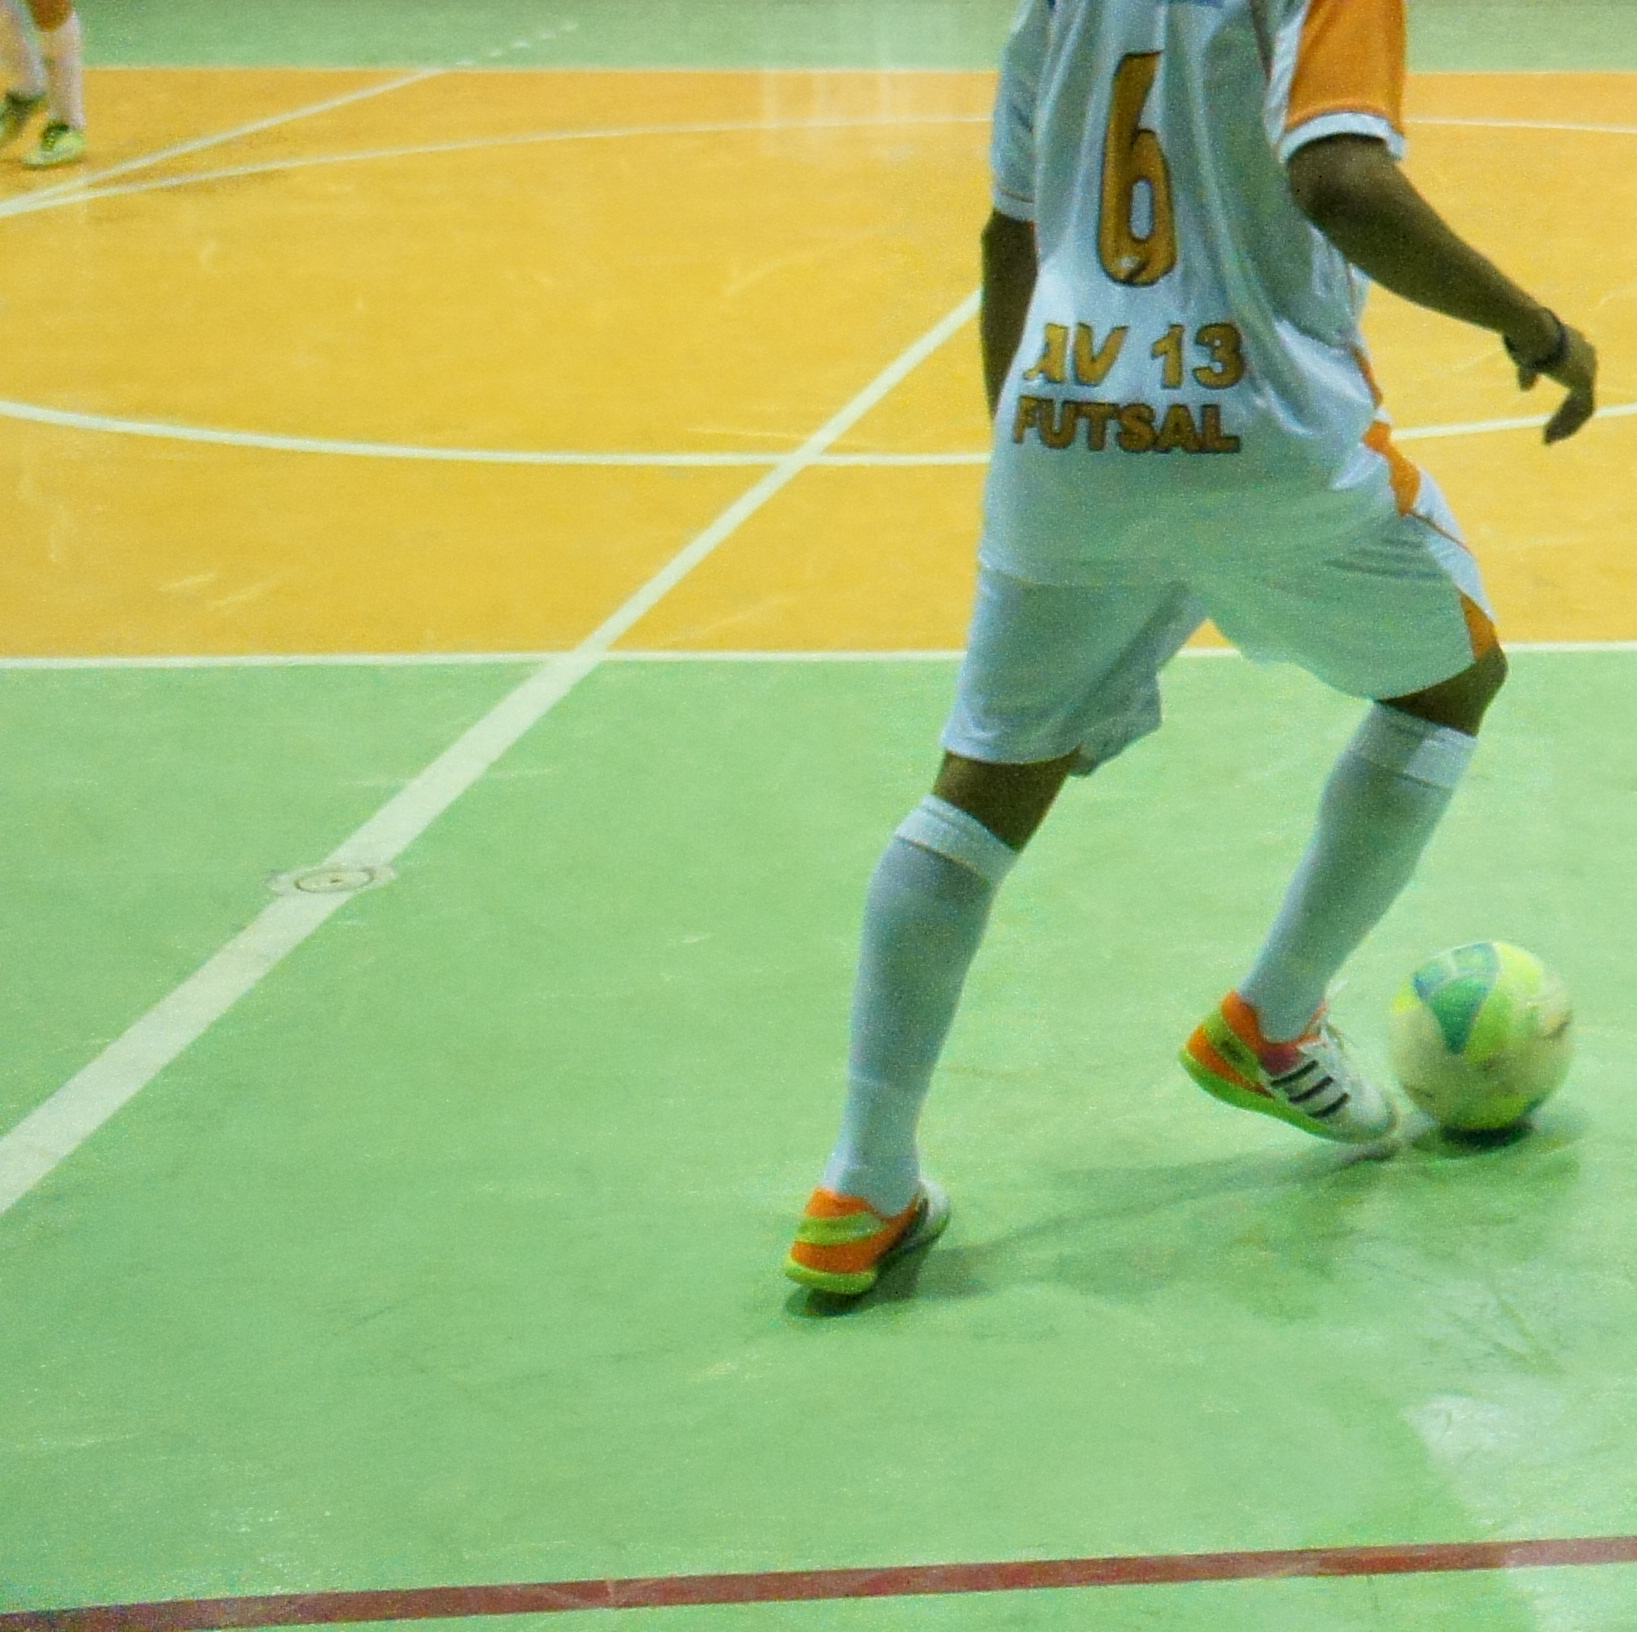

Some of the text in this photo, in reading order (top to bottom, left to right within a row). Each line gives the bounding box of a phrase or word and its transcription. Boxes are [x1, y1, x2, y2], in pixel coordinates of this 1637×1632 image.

[1095, 50, 1178, 288] 6
[1151, 318, 1248, 390] 13
[1012, 394, 1242, 455] FUTSAL
